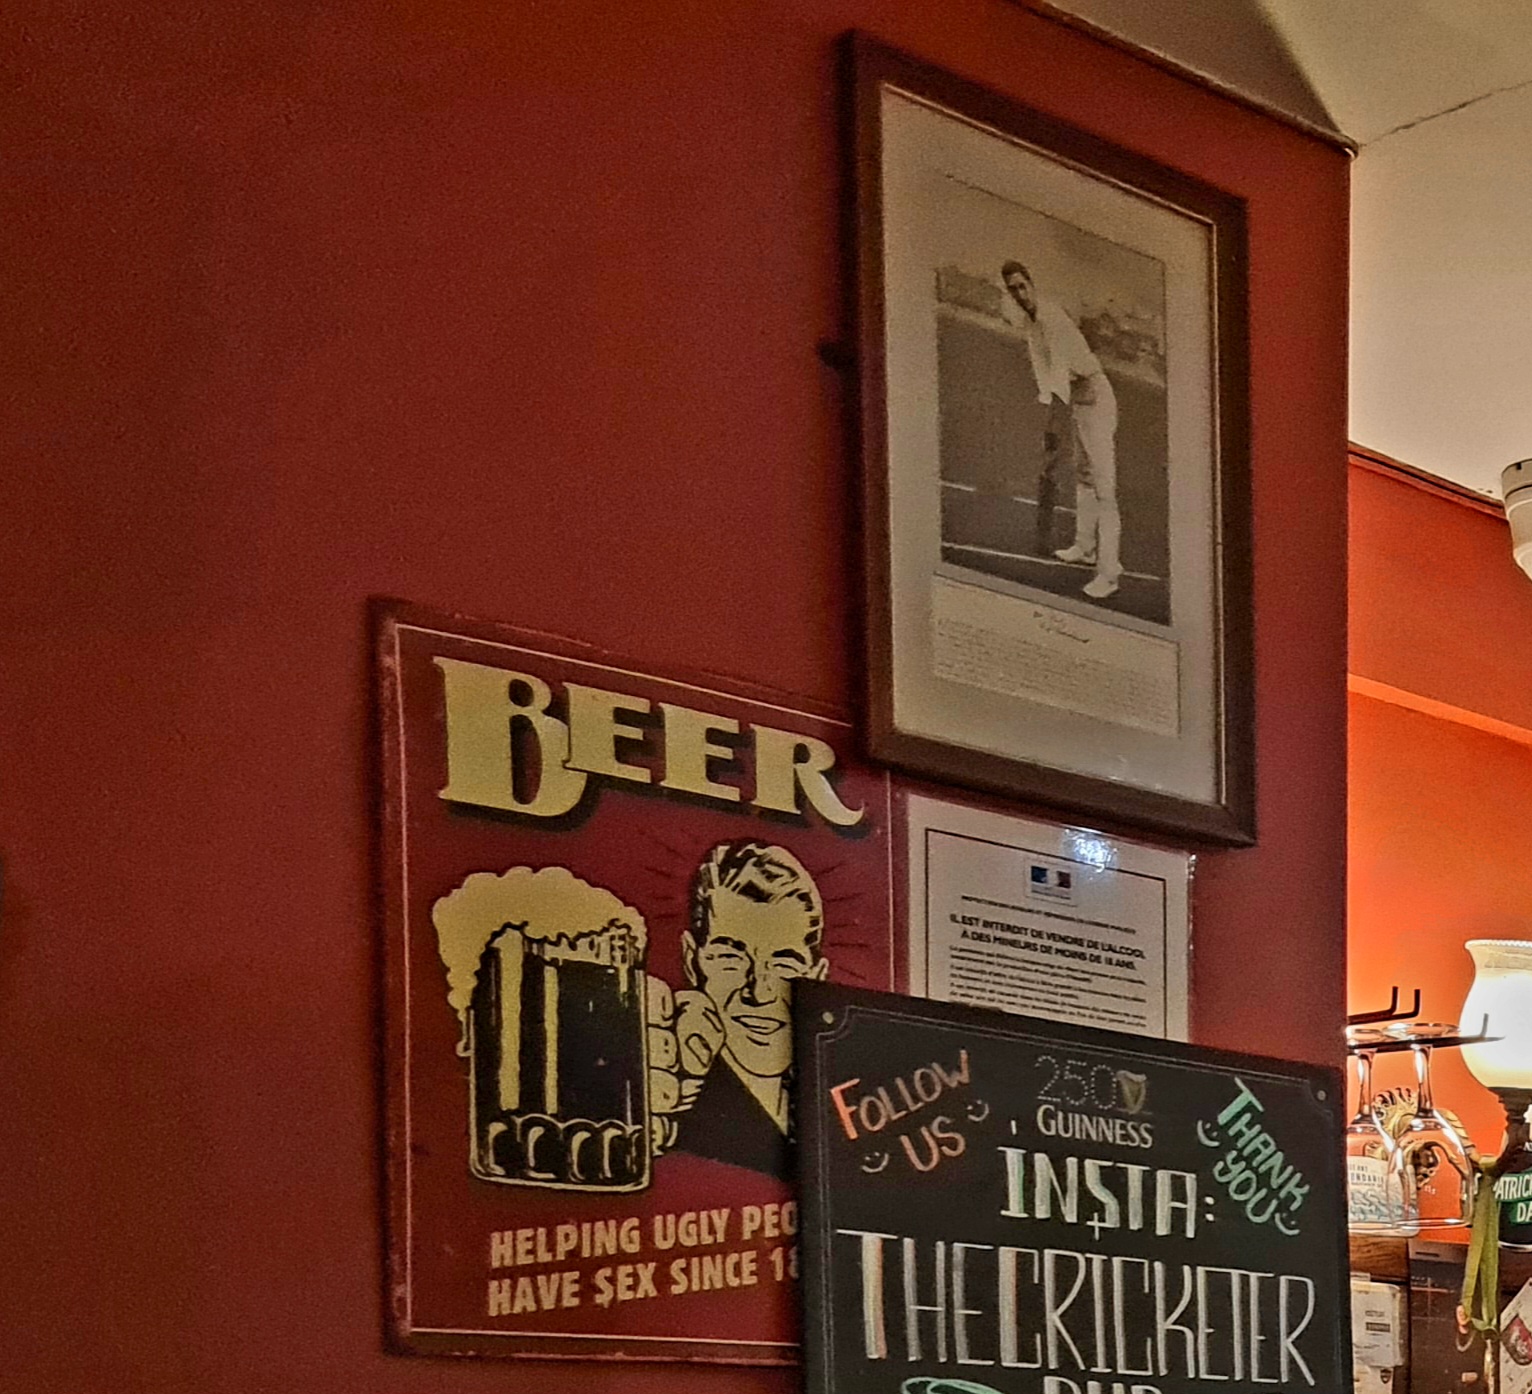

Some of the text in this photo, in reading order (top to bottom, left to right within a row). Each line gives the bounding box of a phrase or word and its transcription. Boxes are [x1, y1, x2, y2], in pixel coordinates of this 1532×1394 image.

[433, 656, 864, 827] BEER
[962, 915, 980, 927] EST
[982, 919, 1030, 937] INTERDIT
[1030, 928, 1045, 940] DE
[1046, 931, 1085, 948] VENDRE
[1087, 940, 1101, 951] DE
[971, 932, 992, 944] DES
[993, 936, 1038, 953] MINEURS
[1040, 944, 1053, 955] DE
[1089, 953, 1102, 965] DE
[831, 1050, 972, 1140] FOLLOW
[1036, 1055, 1118, 1110] 250
[902, 1117, 965, 1172] US
[1036, 1105, 1153, 1148] GUINNESS
[1217, 1077, 1310, 1211] THANK
[1212, 1149, 1278, 1224] YOU
[489, 1201, 799, 1269] HELPING UGLY PEO
[488, 1271, 581, 1317] HAVE
[594, 1262, 658, 1309] SEX
[670, 1250, 758, 1295] SINCE
